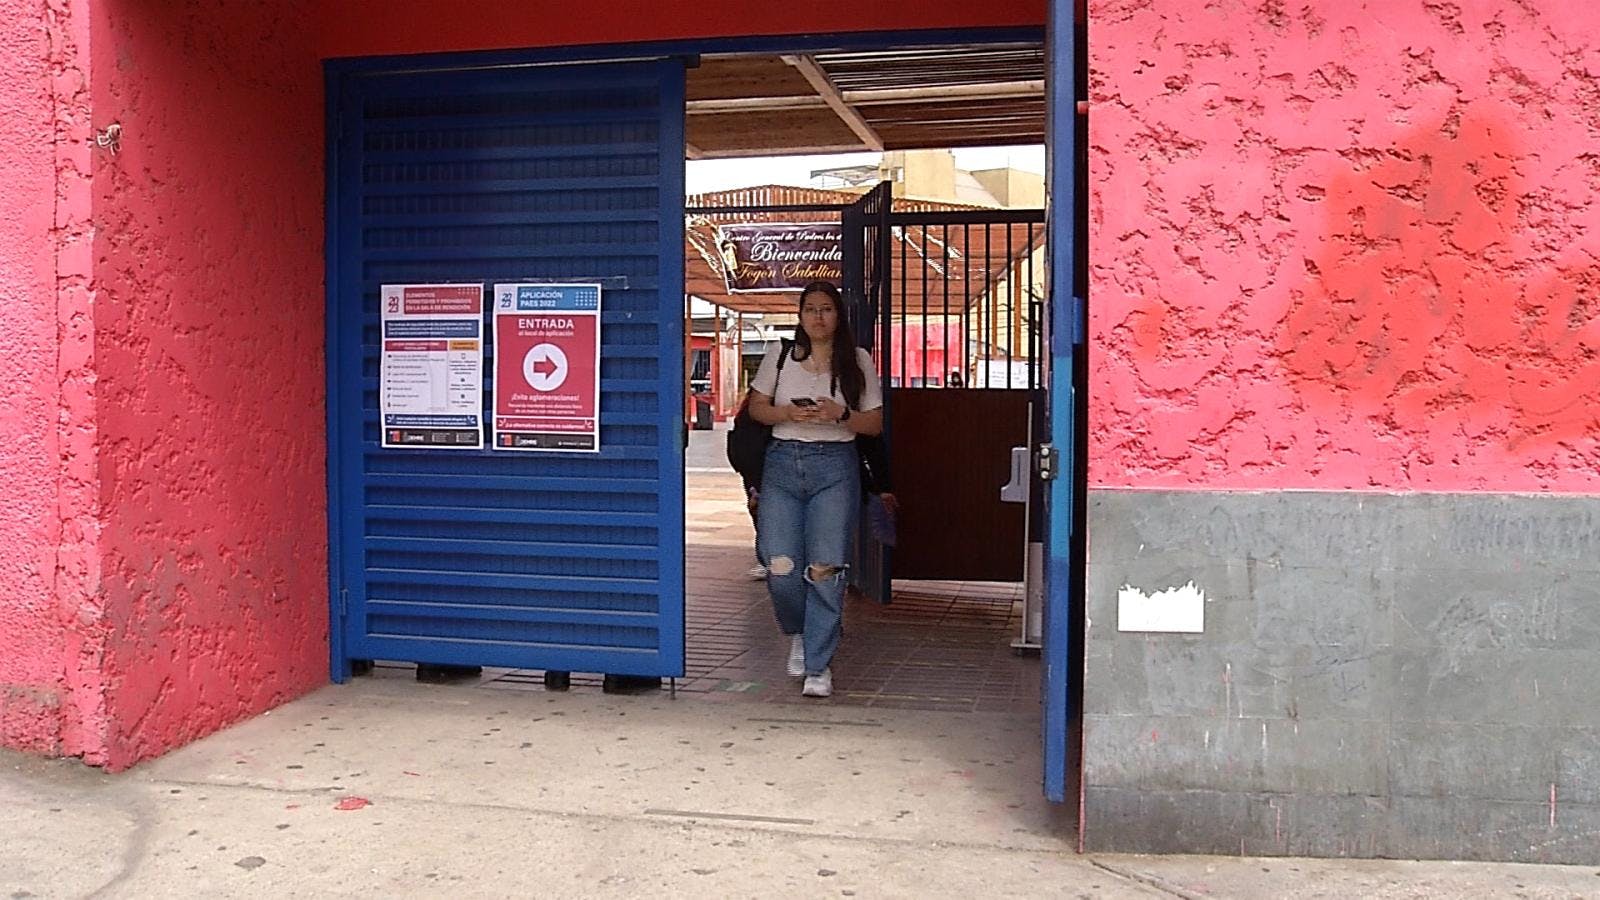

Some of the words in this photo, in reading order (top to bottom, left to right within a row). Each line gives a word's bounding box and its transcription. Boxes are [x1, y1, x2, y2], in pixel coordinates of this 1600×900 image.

[752, 231, 783, 242] General
[784, 232, 794, 241] de
[738, 262, 776, 284] Fogón
[520, 291, 563, 299] APLICACIÓN
[518, 318, 575, 329] ENTRADA
[546, 330, 574, 338] aplicación
